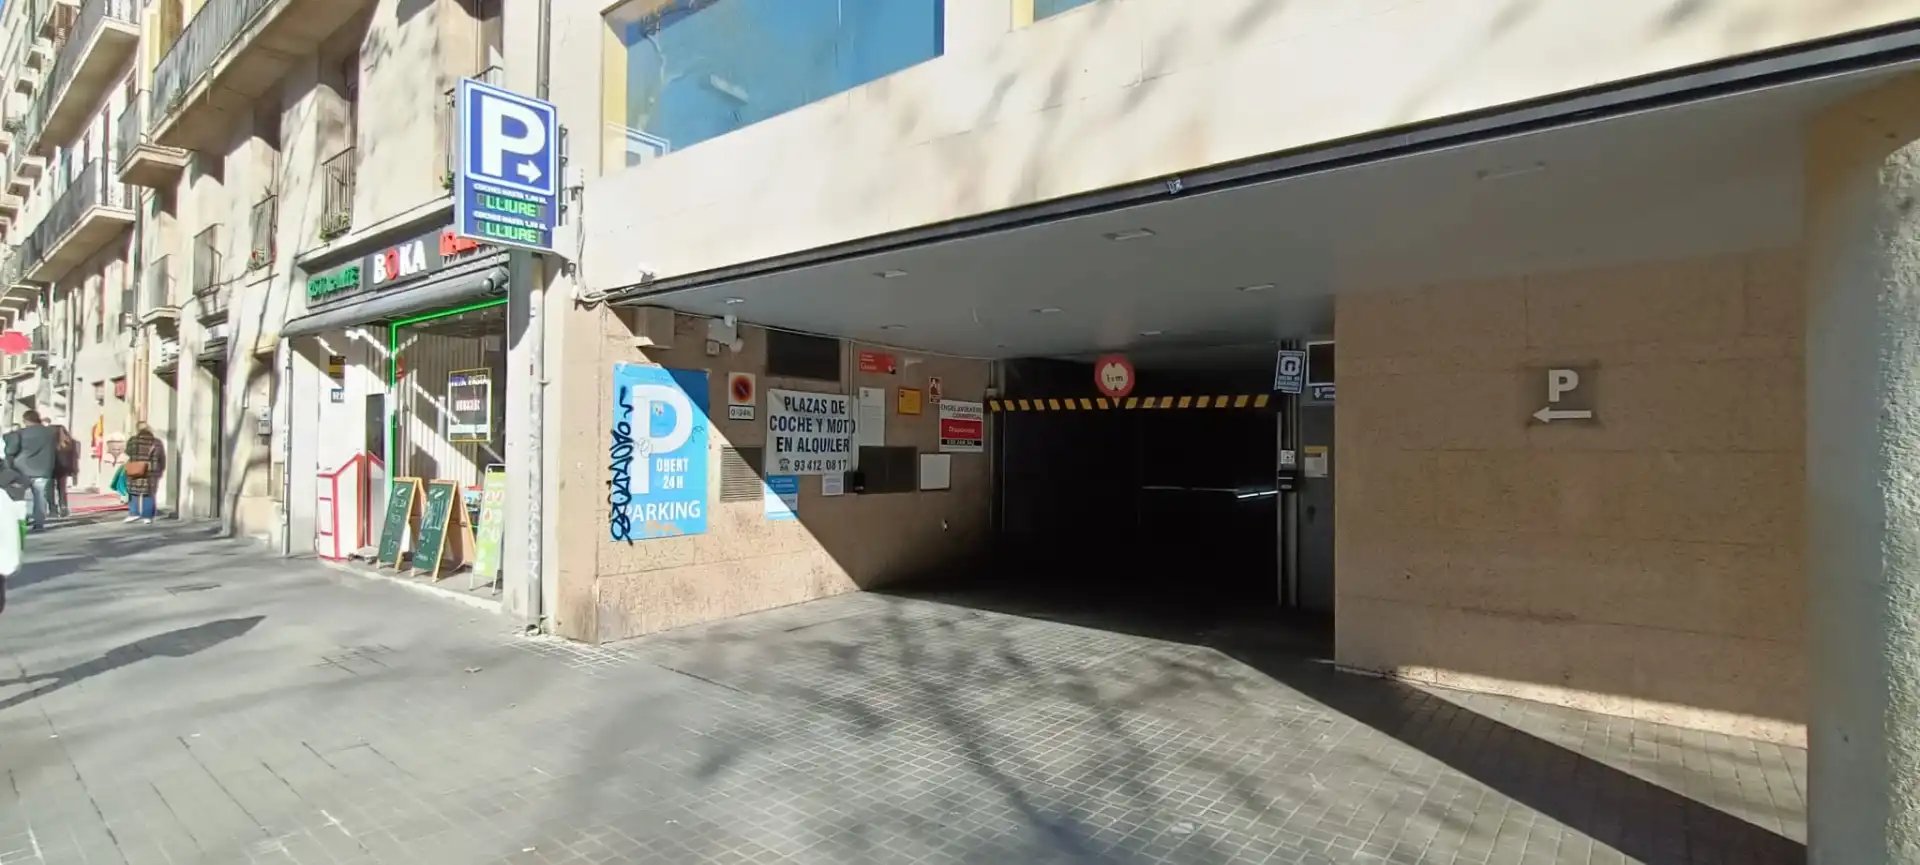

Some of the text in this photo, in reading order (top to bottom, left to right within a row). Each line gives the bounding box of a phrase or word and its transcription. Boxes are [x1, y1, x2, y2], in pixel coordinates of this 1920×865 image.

[481, 94, 546, 178] P
[485, 194, 537, 217] LLIURE
[485, 221, 537, 243] LLIURE
[374, 240, 428, 284] BOKA
[1549, 369, 1579, 402] P
[784, 396, 845, 415] PLAZAS DE
[769, 415, 812, 433] COCHE
[815, 418, 823, 433] Y
[631, 384, 693, 494] P
[776, 436, 850, 454] EN ALQUILER
[794, 459, 805, 471] 93
[807, 459, 822, 471] 412
[663, 475, 684, 489] 24 H
